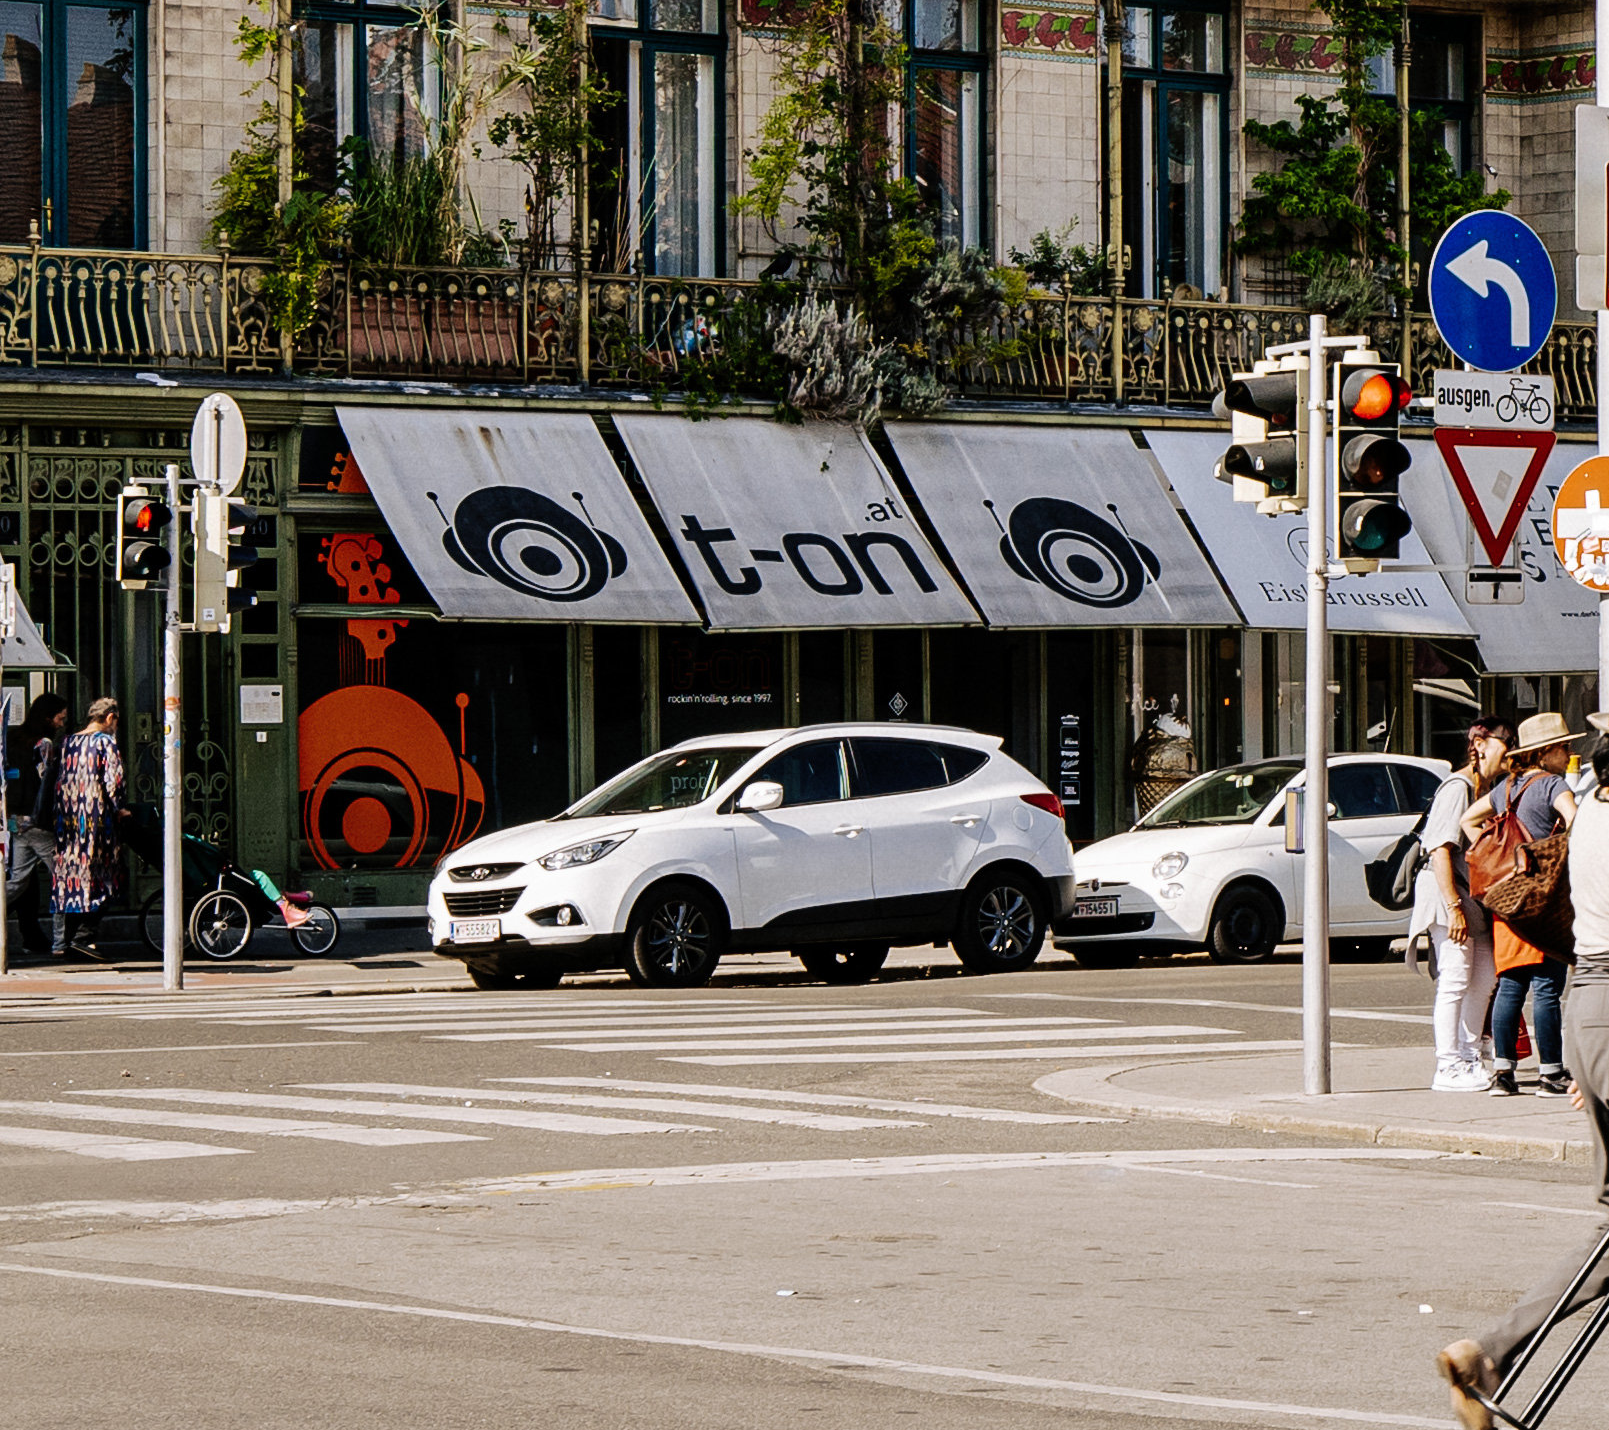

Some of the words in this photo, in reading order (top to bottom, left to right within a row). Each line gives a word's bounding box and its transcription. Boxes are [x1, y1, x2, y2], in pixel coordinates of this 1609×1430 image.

[1438, 386, 1494, 413] ausgen.
[680, 514, 940, 596] t-on
[864, 497, 904, 523] .at
[732, 694, 752, 704] since
